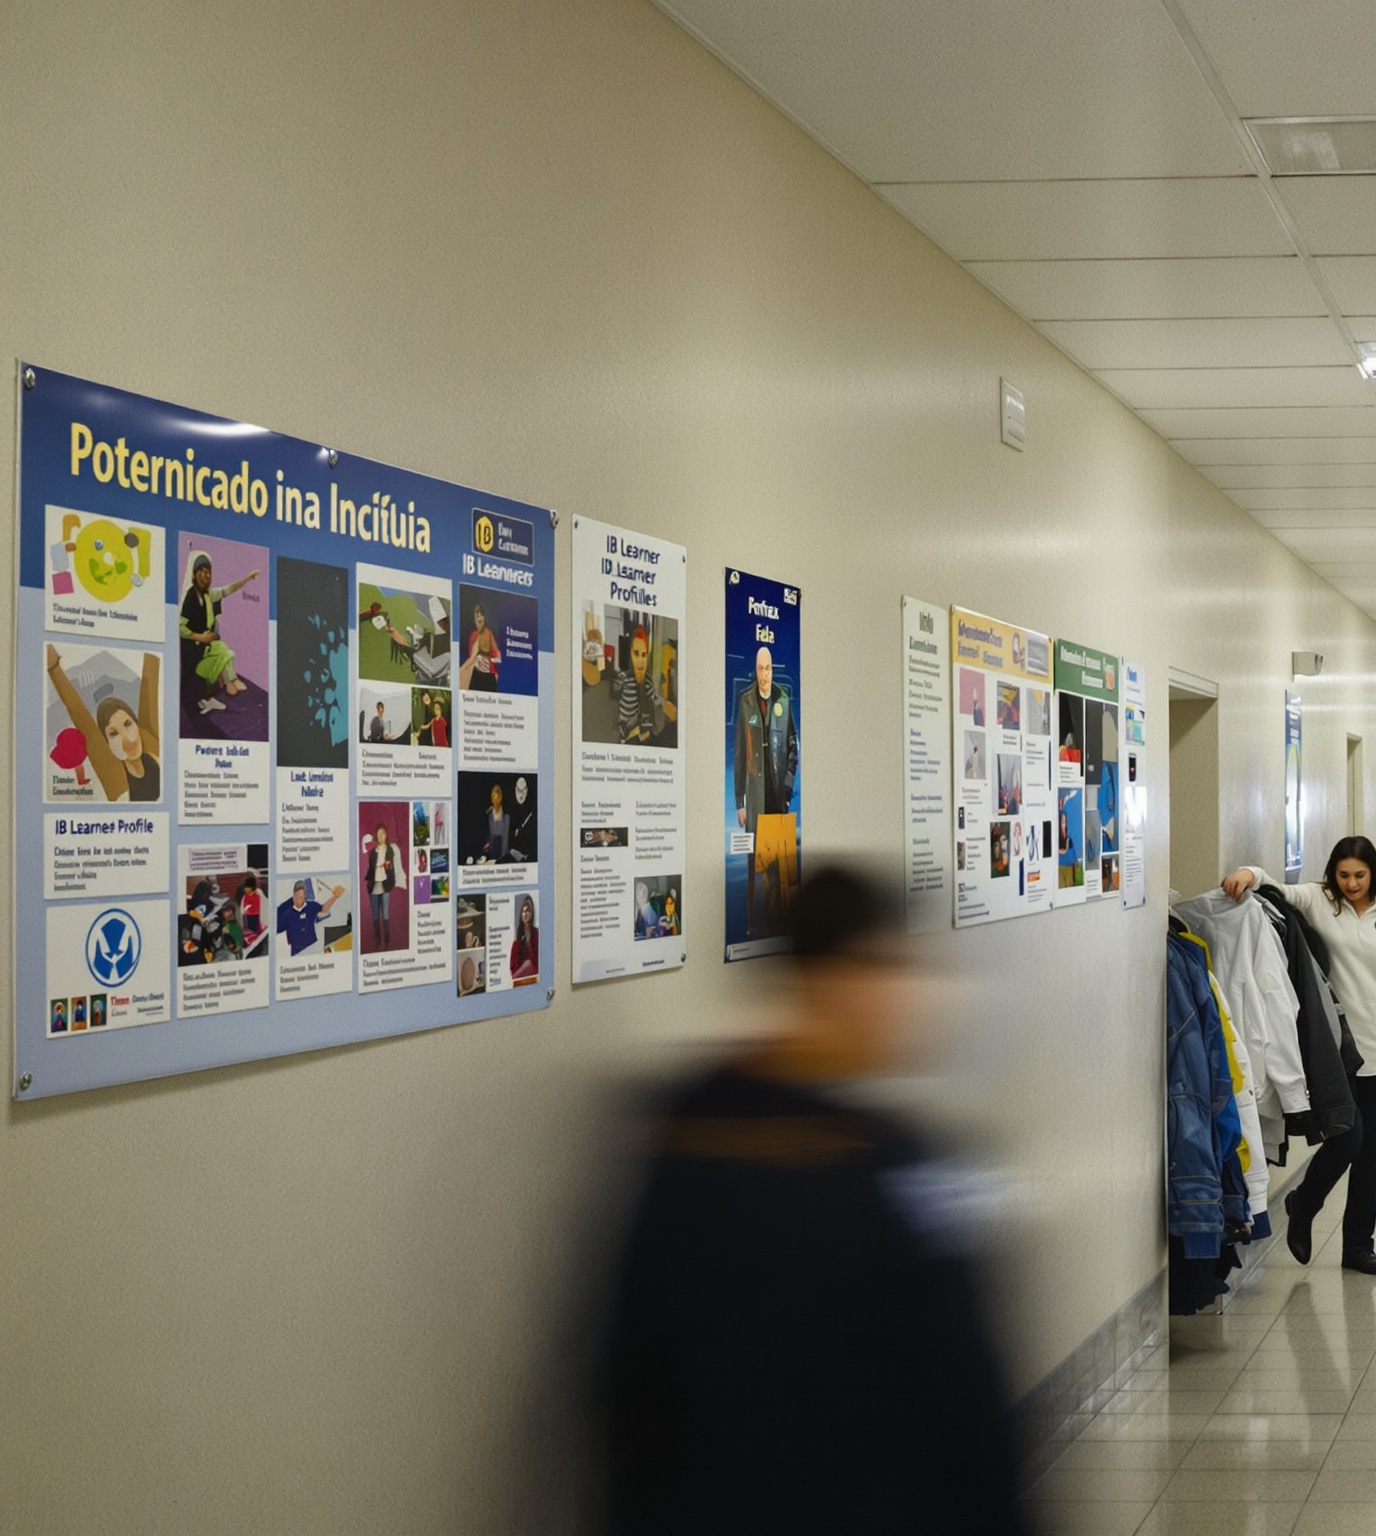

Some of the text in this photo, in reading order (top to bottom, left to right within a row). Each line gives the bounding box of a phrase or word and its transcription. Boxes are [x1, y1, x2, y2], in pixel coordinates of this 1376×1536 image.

[71, 422, 269, 518] Poternicado
[276, 469, 321, 530] ina
[607, 534, 617, 554] IB
[463, 552, 475, 575] IB
[55, 820, 67, 835] IB
[118, 817, 154, 833] Profile
